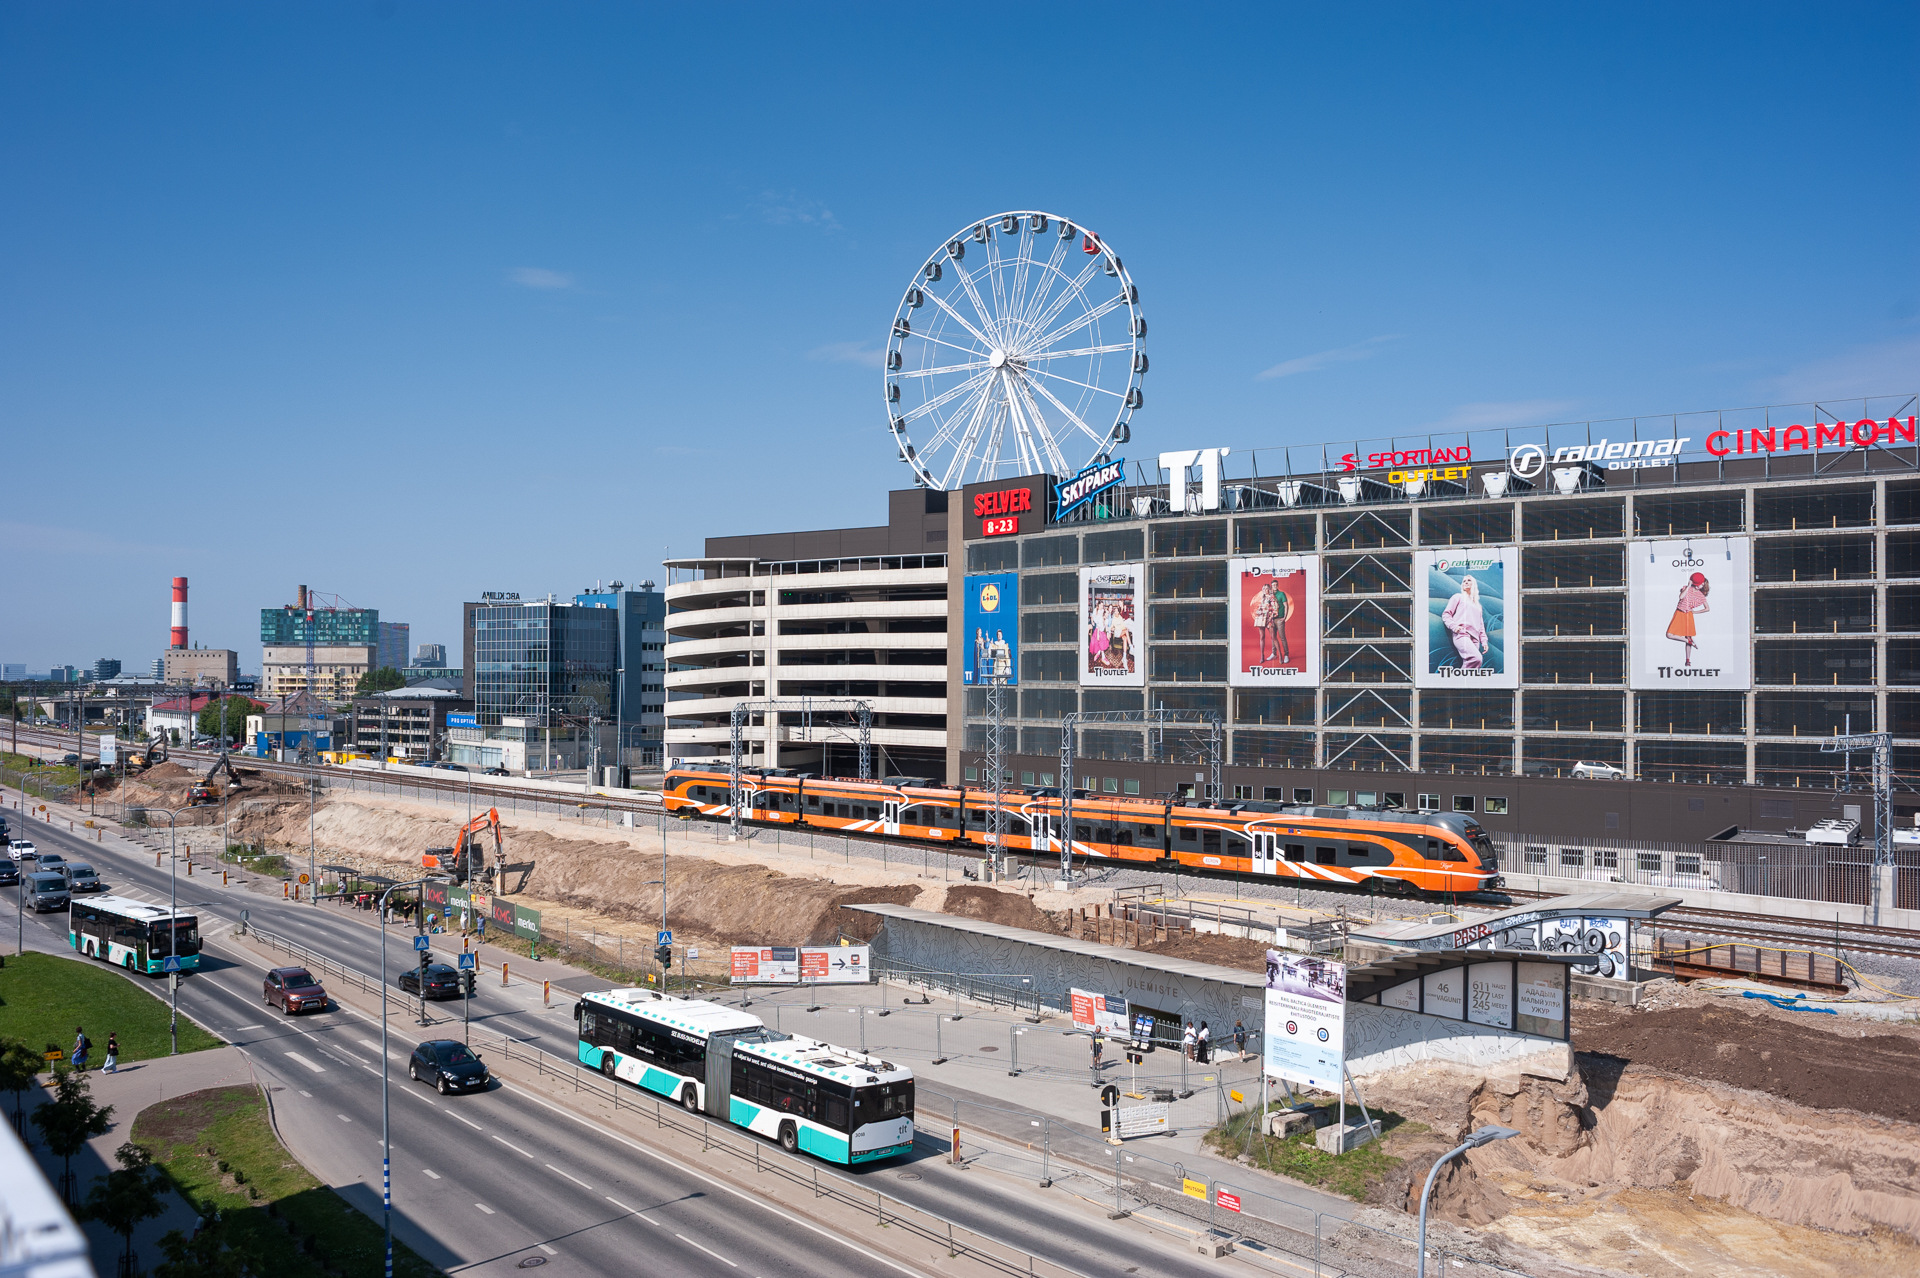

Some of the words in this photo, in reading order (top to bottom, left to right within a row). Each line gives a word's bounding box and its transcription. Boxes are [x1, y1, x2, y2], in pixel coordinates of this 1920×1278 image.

[1705, 416, 1916, 456] CINAMON
[1368, 446, 1472, 468] SPORTLAND
[1552, 438, 1691, 464] rademar
[1608, 457, 1672, 471] OUTLET
[1159, 447, 1230, 511] T1
[1388, 466, 1472, 484] OUTLET
[1061, 462, 1121, 507] SKYPARK
[974, 487, 1031, 516] SELVER
[987, 520, 1013, 534] 8-23
[1672, 559, 1704, 567] OHOO
[1263, 668, 1297, 676] OUTLET
[1453, 669, 1493, 677] OUTLET
[1674, 669, 1720, 677] OUTLET
[427, 888, 444, 904] KMG
[494, 905, 511, 923] KMG
[1127, 976, 1179, 998] ÜLEMISTE
[1437, 982, 1449, 994] 46
[1472, 980, 1489, 992] 611
[1491, 982, 1507, 990] NAIST
[1472, 989, 1491, 1001] 277
[1491, 992, 1505, 1000] LAST
[1525, 988, 1556, 999] АДАДЫМ
[1290, 998, 1307, 1007] BALTICA
[1307, 1001, 1327, 1011] ÜLEMISTE
[1472, 999, 1490, 1011] 245
[1491, 1002, 1508, 1010] MEEST
[1520, 996, 1544, 1006] МАЛЫЙ
[1531, 1005, 1550, 1015] УЖУР
[898, 1125, 908, 1135] tlt
